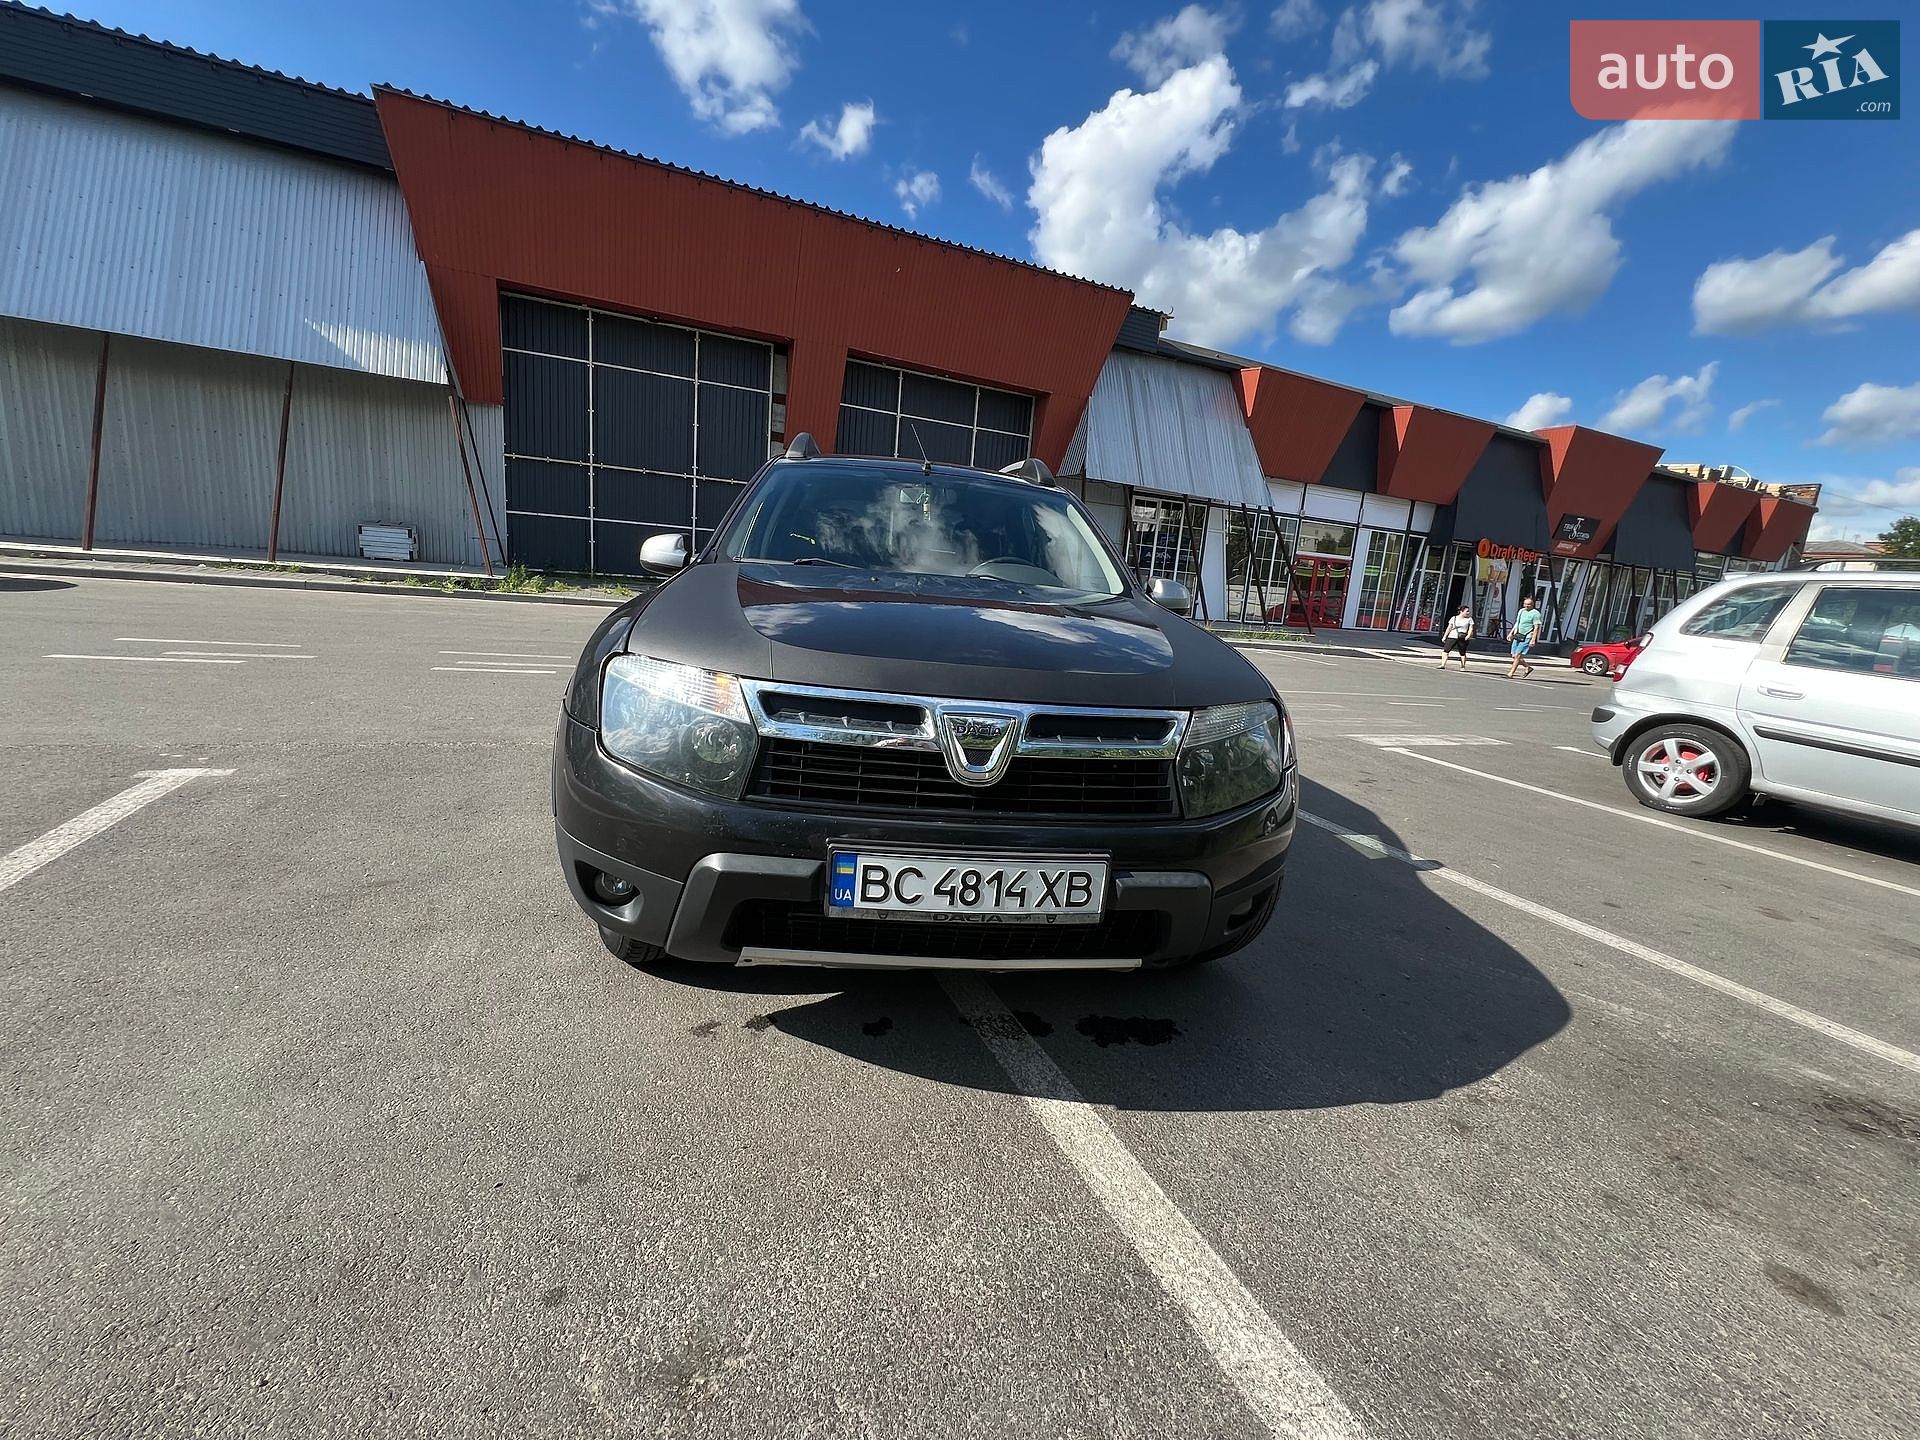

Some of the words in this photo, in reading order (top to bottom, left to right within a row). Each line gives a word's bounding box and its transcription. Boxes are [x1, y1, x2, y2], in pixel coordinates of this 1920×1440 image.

[1490, 543, 1516, 560] Draft
[1516, 547, 1538, 563] Beer
[956, 723, 1001, 736] DACIA
[834, 888, 852, 901] UA
[932, 913, 1004, 923] DACIA
